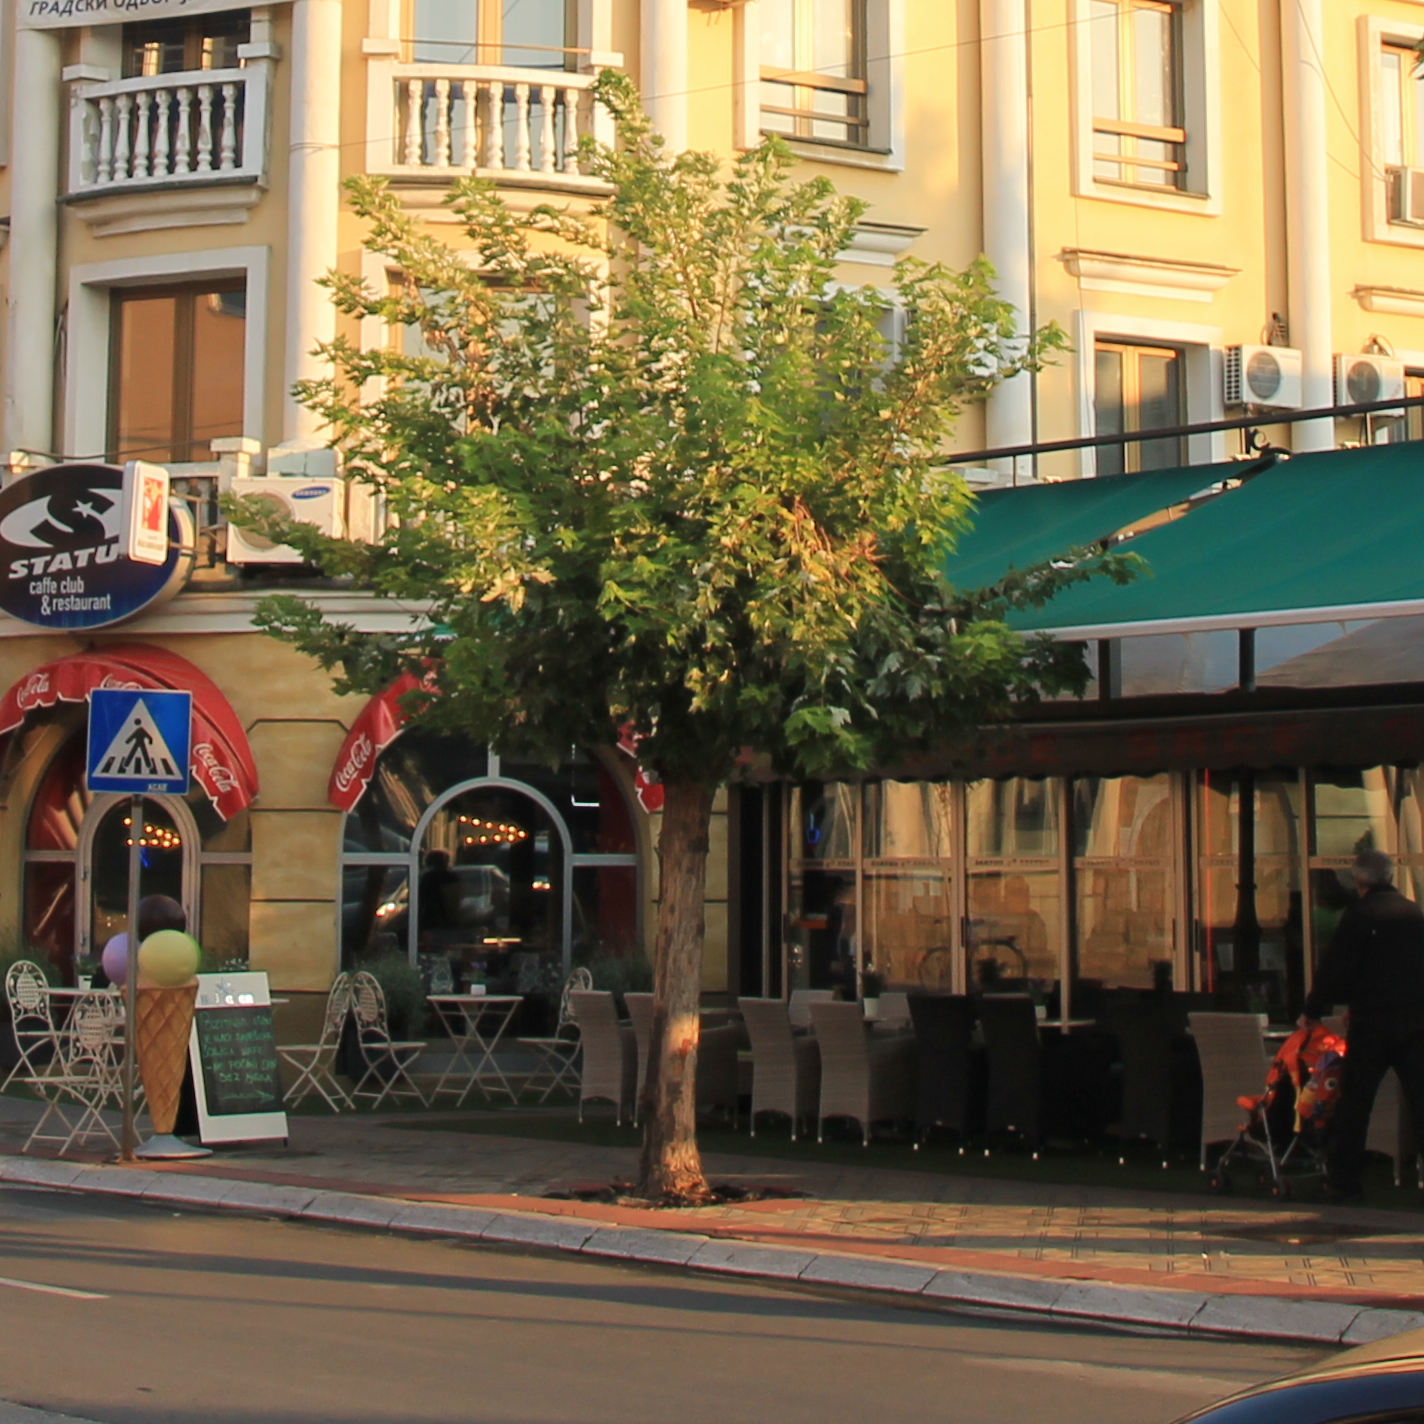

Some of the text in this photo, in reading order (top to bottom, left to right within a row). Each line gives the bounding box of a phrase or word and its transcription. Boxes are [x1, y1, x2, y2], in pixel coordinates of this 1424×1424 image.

[8, 542, 122, 579] STATU
[29, 576, 84, 594] caffe club
[40, 593, 111, 616] & restaurant
